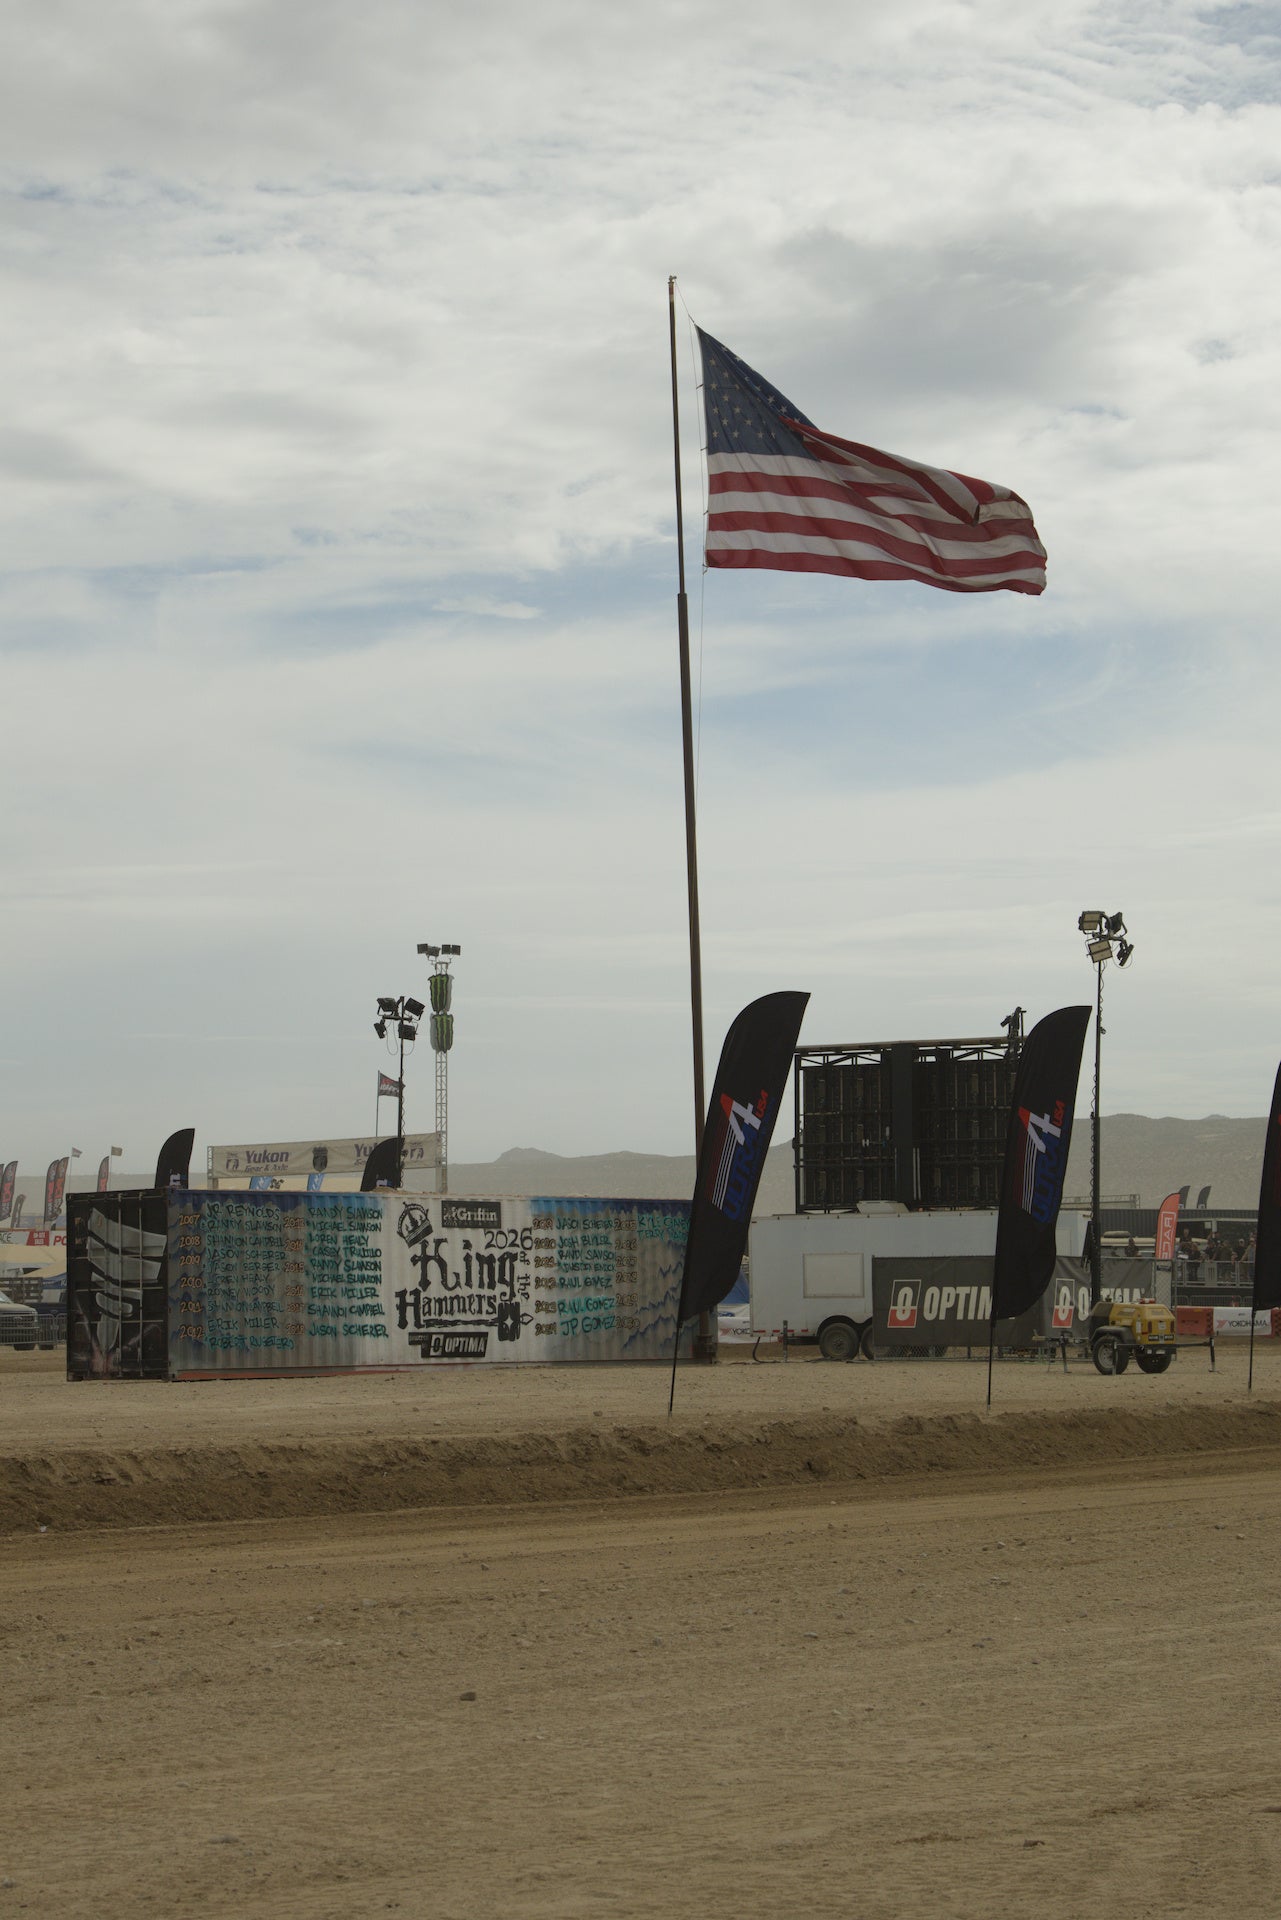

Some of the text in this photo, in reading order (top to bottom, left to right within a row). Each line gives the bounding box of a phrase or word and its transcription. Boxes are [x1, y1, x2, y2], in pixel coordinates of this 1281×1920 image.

[246, 1150, 289, 1164] Yukon
[179, 1214, 200, 1226] 2007
[206, 1202, 281, 1221] JR REYNOLDS
[342, 1234, 369, 1246] HEALY
[484, 1229, 533, 1251] 2026
[410, 1238, 519, 1303] King
[310, 1286, 379, 1300] ERIK MILLER
[394, 1288, 497, 1330] Hammers
[585, 1297, 616, 1312] GOMEZ
[207, 1316, 281, 1332] ERIK MILLER
[308, 1320, 389, 1338] JASON SCHERER
[560, 1315, 616, 1336] JP GOMEZ
[445, 1336, 487, 1353] OPTIMA
